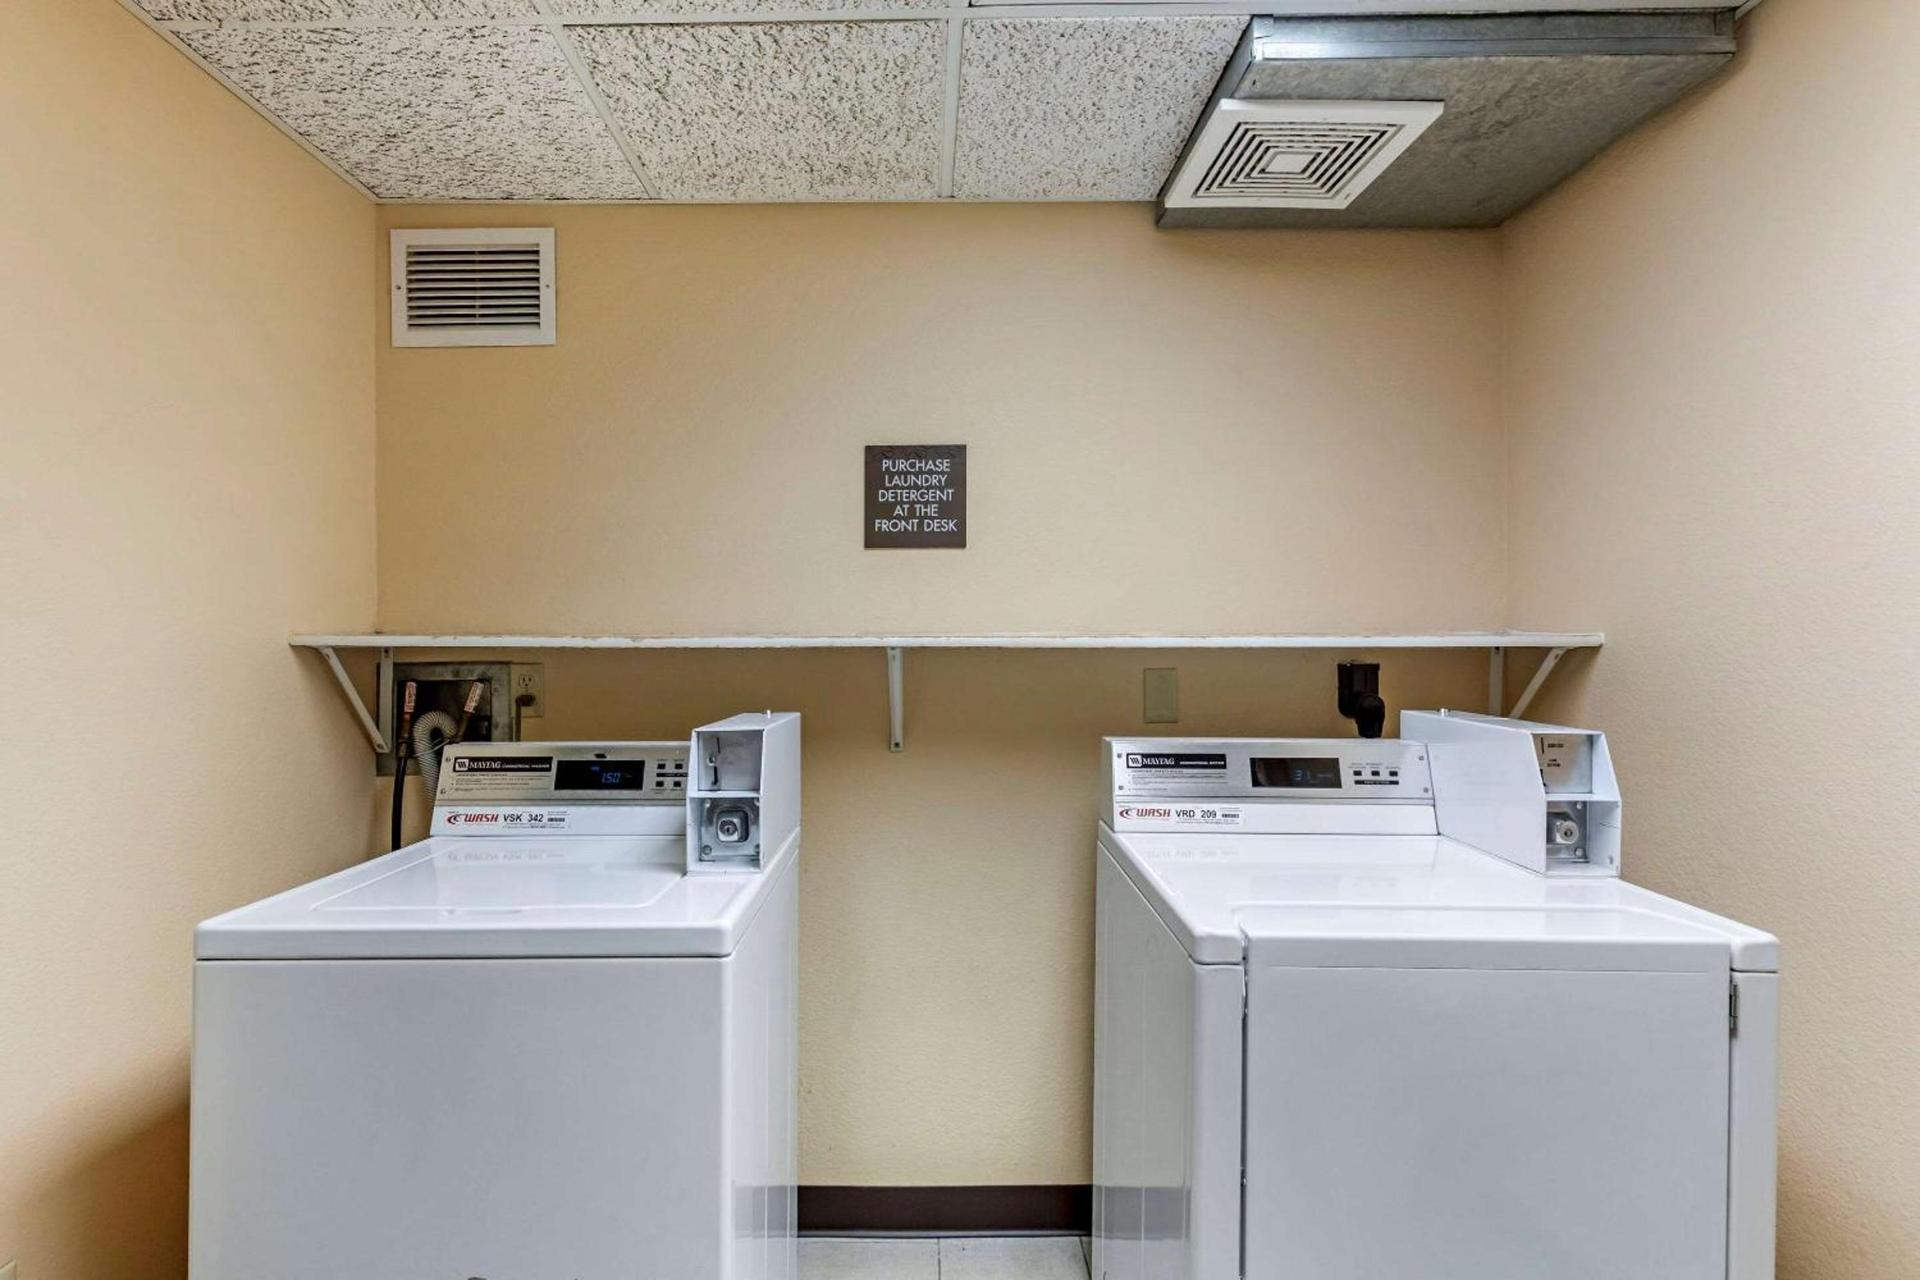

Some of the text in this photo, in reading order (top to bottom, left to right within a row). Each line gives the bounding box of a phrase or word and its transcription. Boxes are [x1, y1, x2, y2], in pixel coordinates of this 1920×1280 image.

[882, 459, 951, 472] PURCHASE
[885, 474, 948, 487] LAUNDRY
[878, 489, 954, 502] DETERGENT
[893, 504, 939, 517] AT THE
[874, 519, 958, 532] FRONT DESK
[469, 760, 501, 769] MAYTAG
[1142, 757, 1175, 766] MAYTAG
[464, 813, 499, 823] WASH
[503, 813, 523, 823] VSK
[527, 813, 544, 823] 342
[1136, 808, 1171, 818] WASH
[1175, 809, 1196, 818] VRD
[1201, 809, 1217, 819] 209
